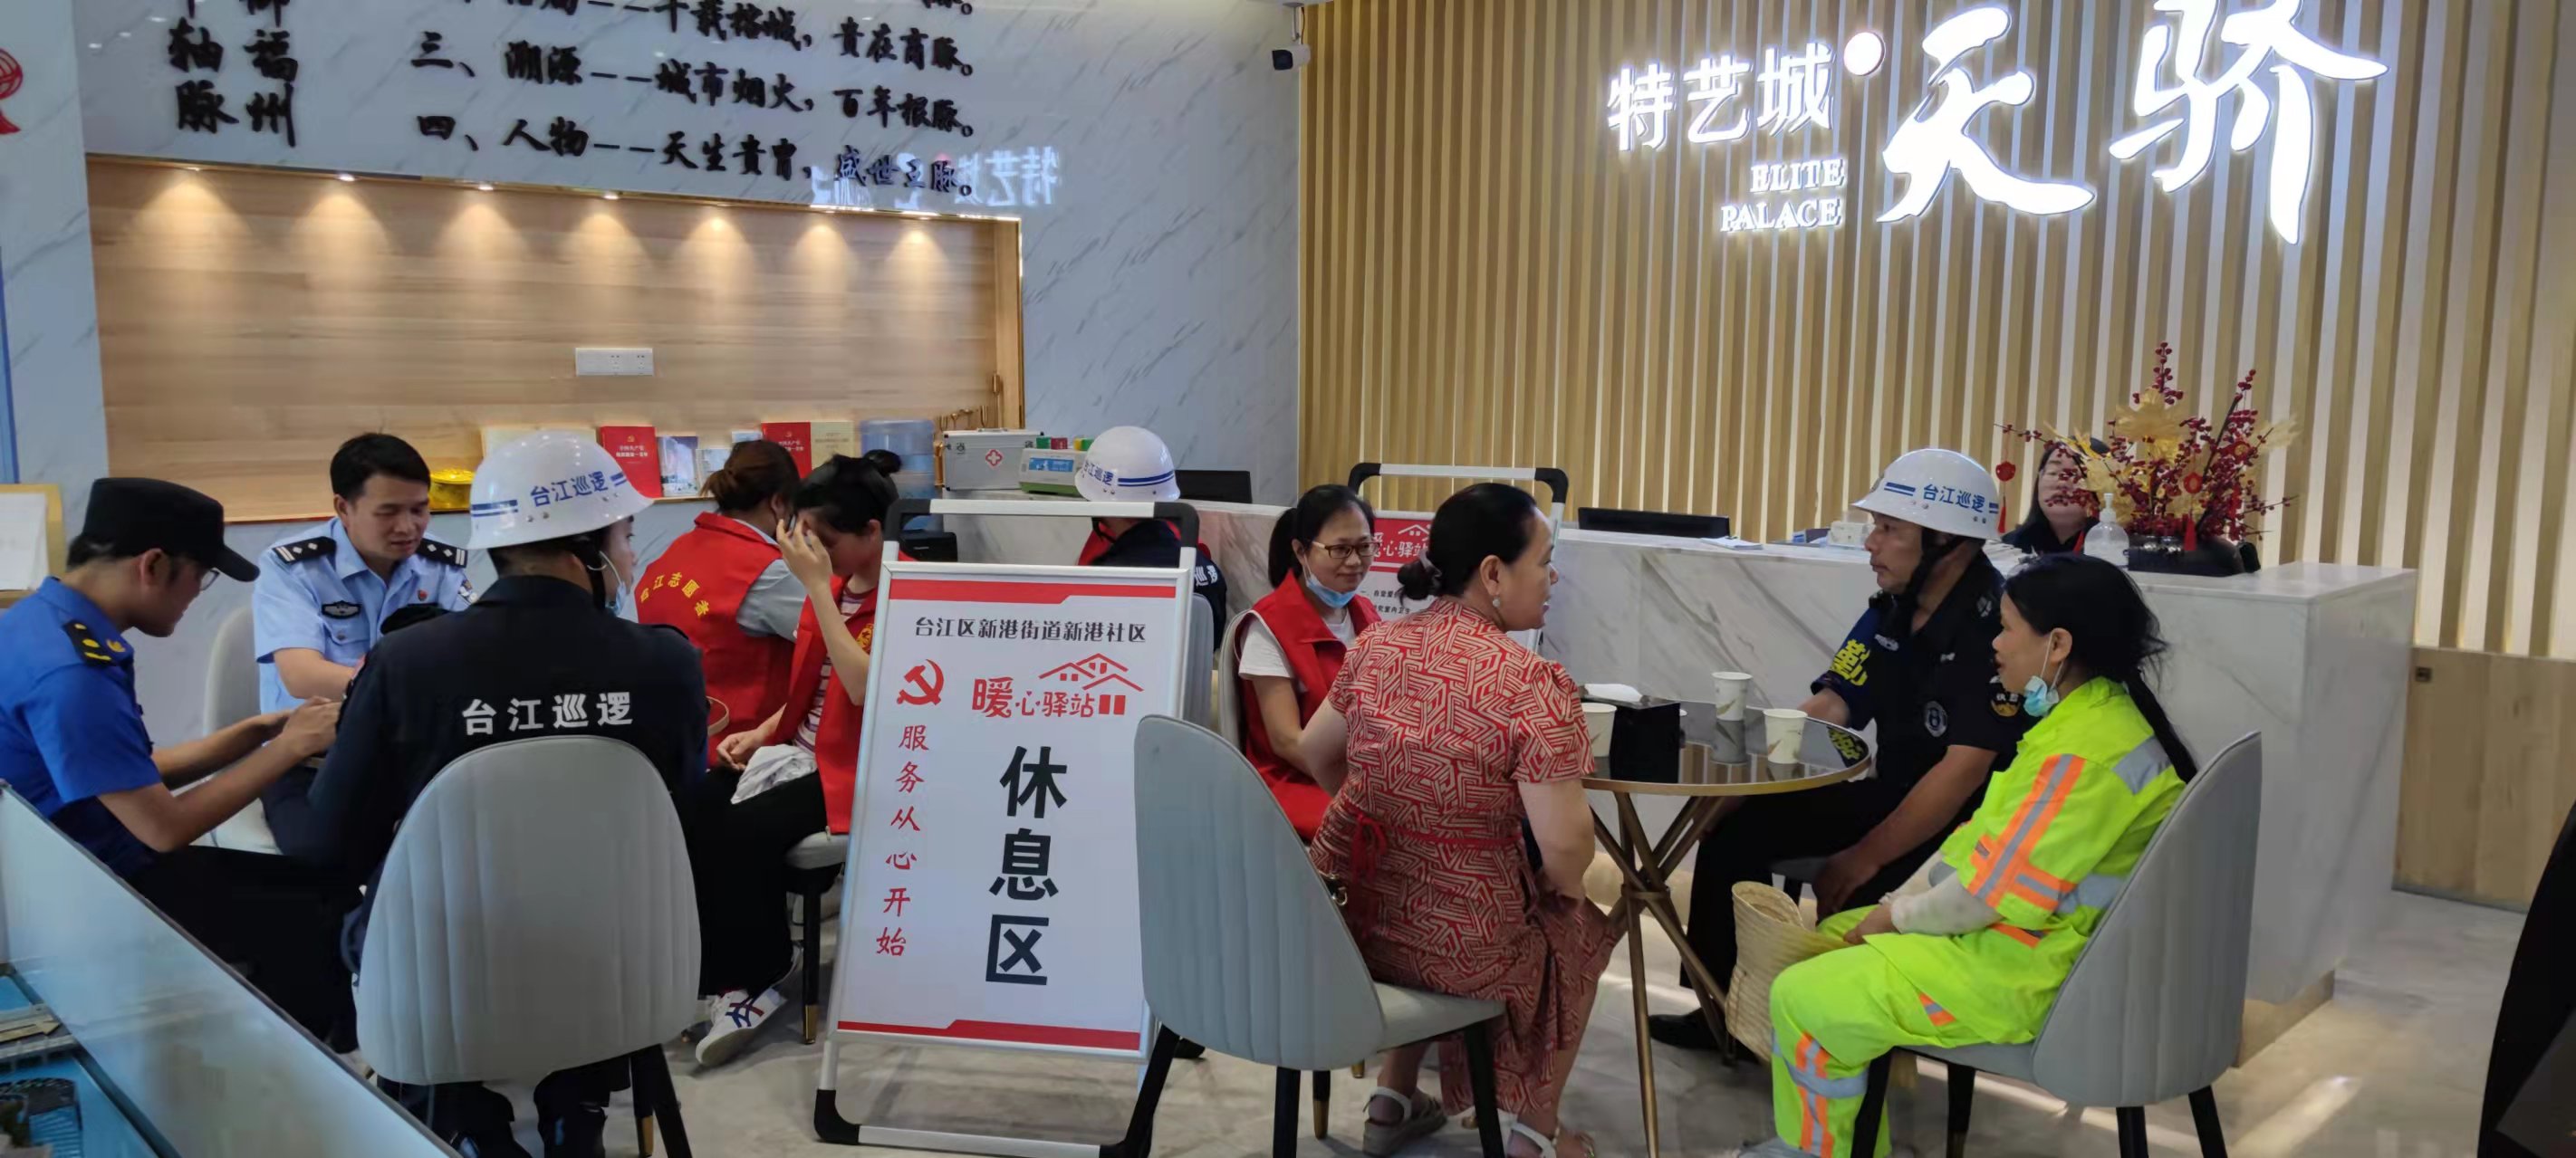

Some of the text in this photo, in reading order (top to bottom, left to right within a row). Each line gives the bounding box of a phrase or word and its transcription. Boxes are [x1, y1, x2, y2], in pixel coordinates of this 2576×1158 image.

[1607, 42, 1835, 152] 特艺城
[1875, 0, 2389, 245] 天骄
[1750, 158, 1846, 193] ELITE
[1720, 198, 1842, 232] PALACE
[530, 470, 609, 507] 台江巡逻
[1923, 483, 1985, 513] 台江巡逻
[915, 617, 1147, 644] 台江区新港街道新港社区
[462, 692, 633, 735] 台江巡逻
[876, 725, 929, 957] 服务从心开始
[985, 745, 1068, 986] 休息区
